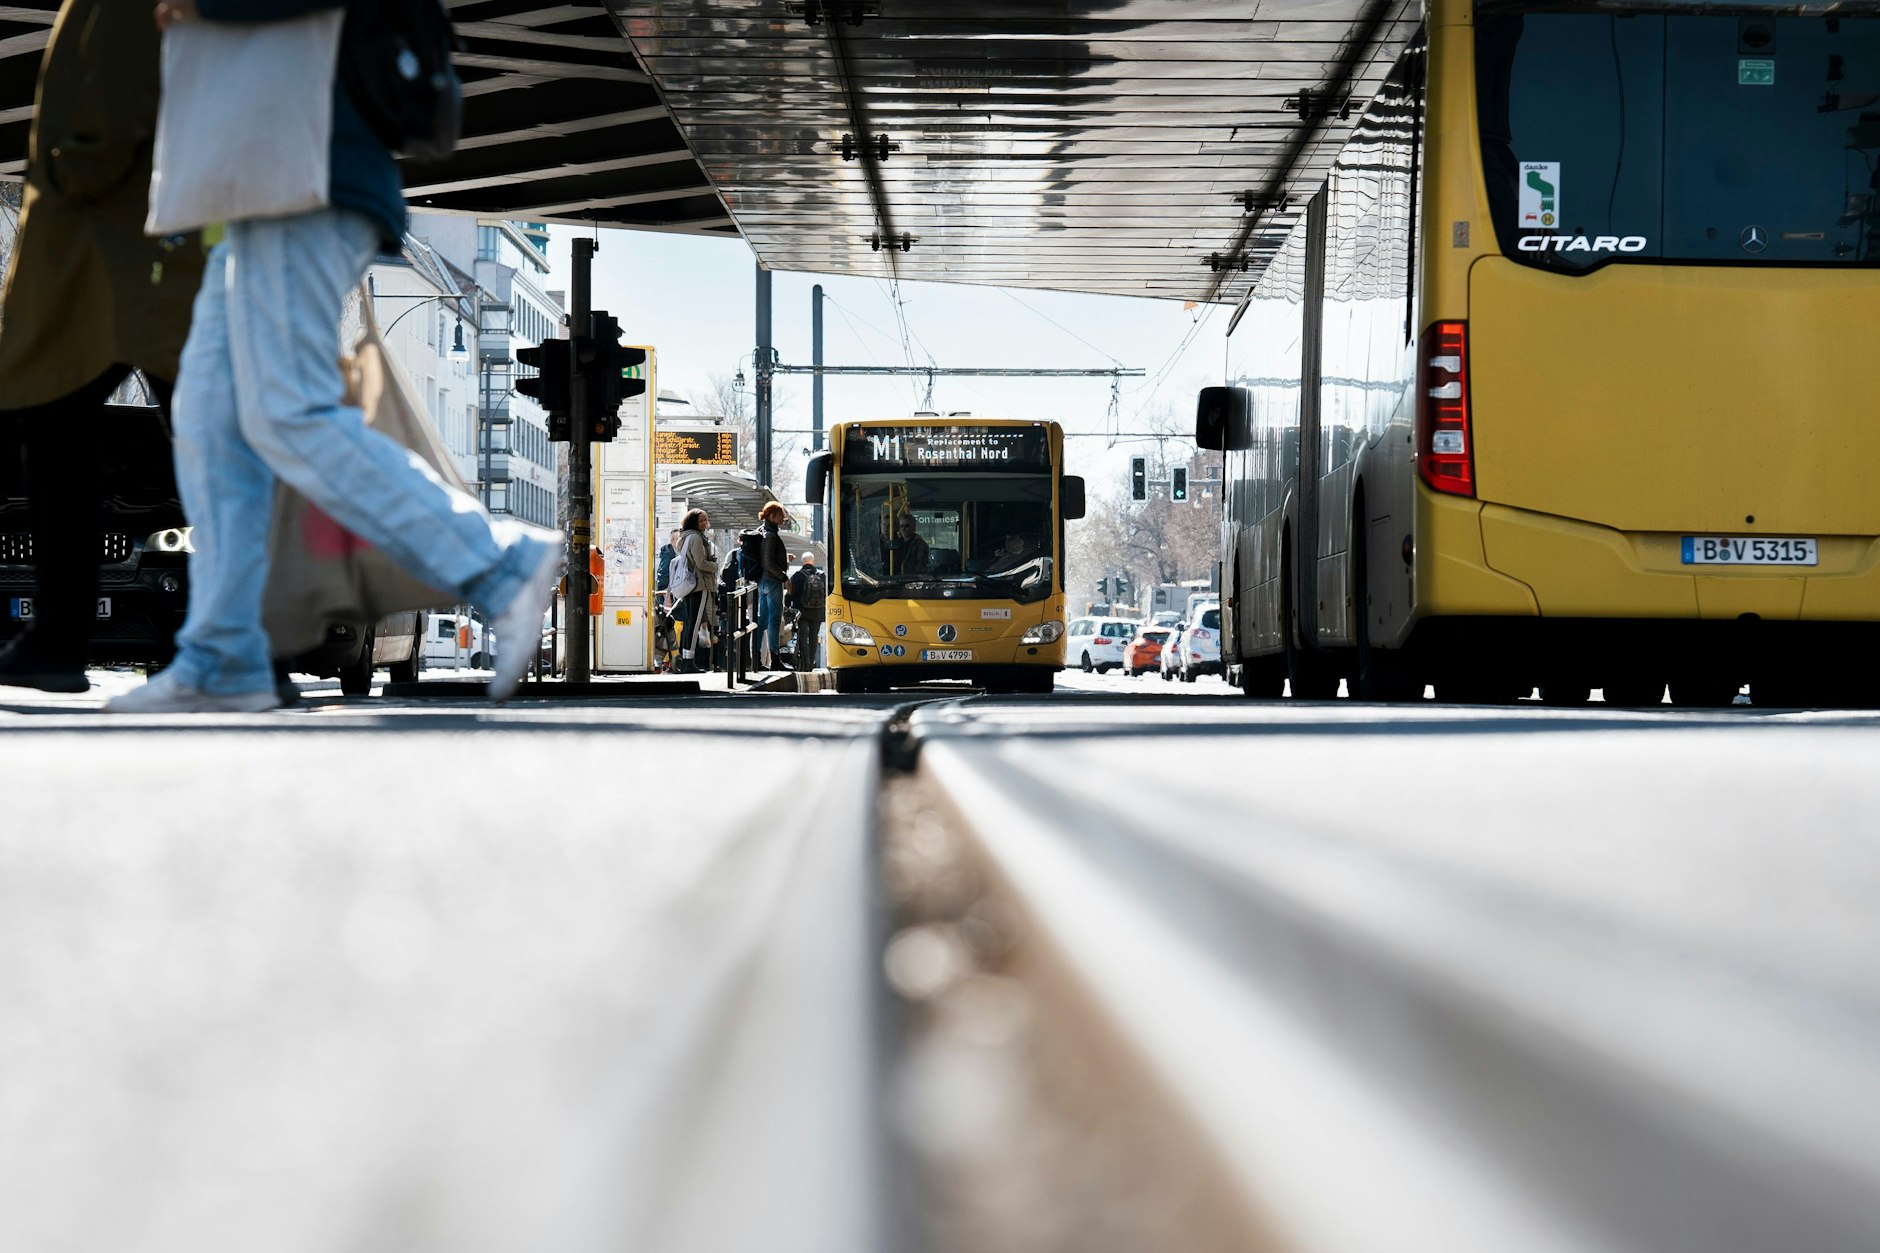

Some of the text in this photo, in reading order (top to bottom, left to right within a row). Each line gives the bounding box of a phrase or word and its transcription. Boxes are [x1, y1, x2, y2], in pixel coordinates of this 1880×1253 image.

[1518, 235, 1647, 252] CITARO
[873, 434, 900, 460] M1
[918, 447, 1008, 460] Rosenthal Nord
[1704, 540, 1717, 560] B
[1733, 540, 1746, 560] V
[1752, 540, 1807, 561] 5315
[20, 600, 31, 616] B
[930, 650, 968, 660] B V 4799
